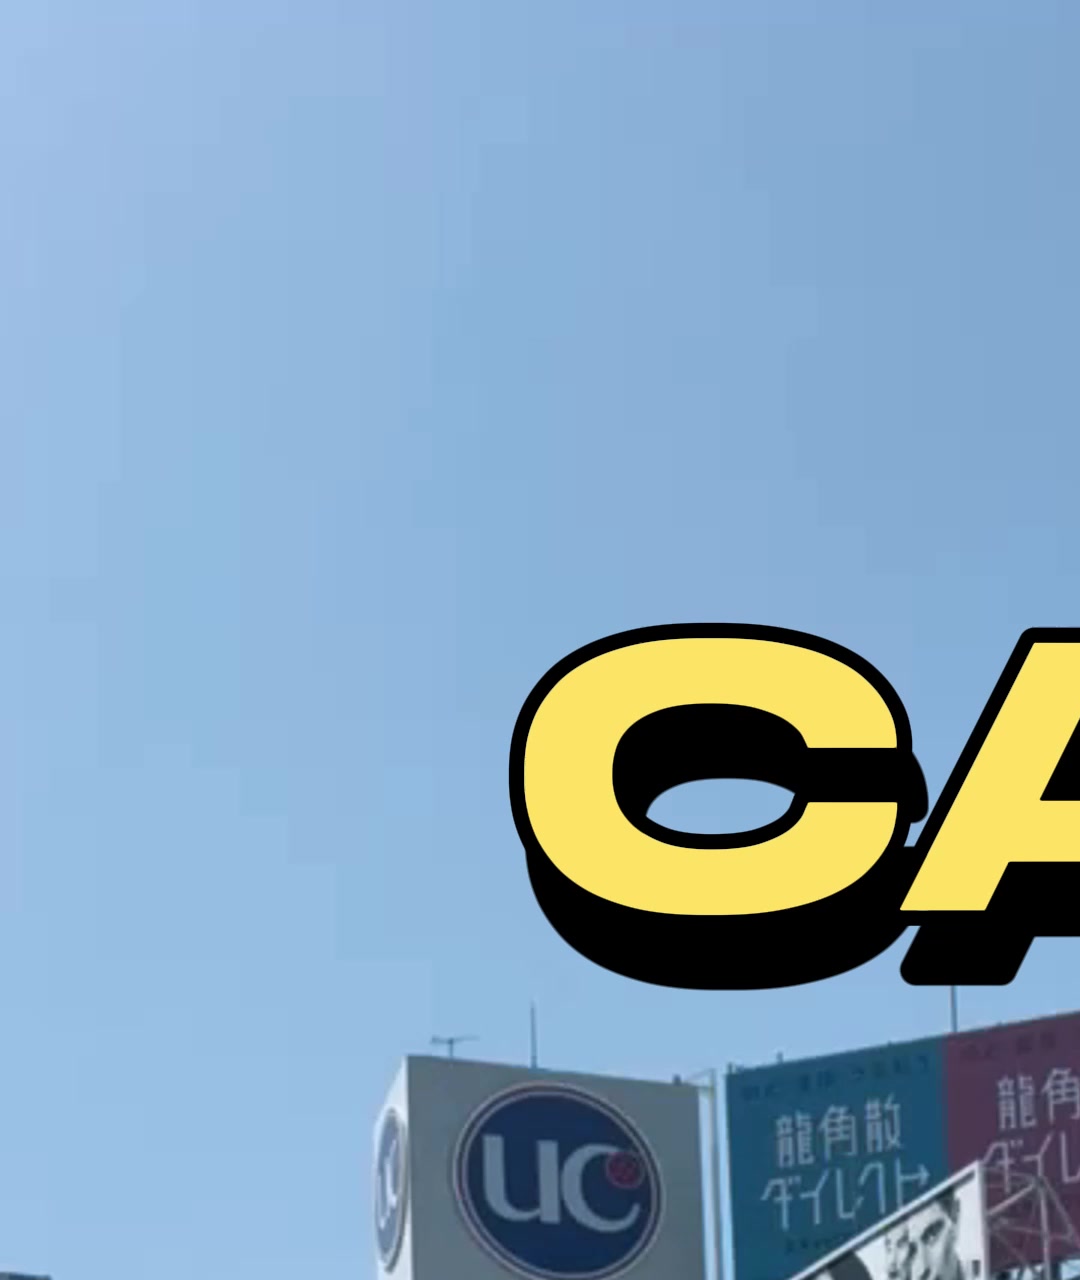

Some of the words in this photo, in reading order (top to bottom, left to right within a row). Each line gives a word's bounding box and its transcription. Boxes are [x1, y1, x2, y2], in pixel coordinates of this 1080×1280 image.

[775, 1094, 902, 1168] 龍角散
[761, 1158, 930, 1231] ダイレクト
